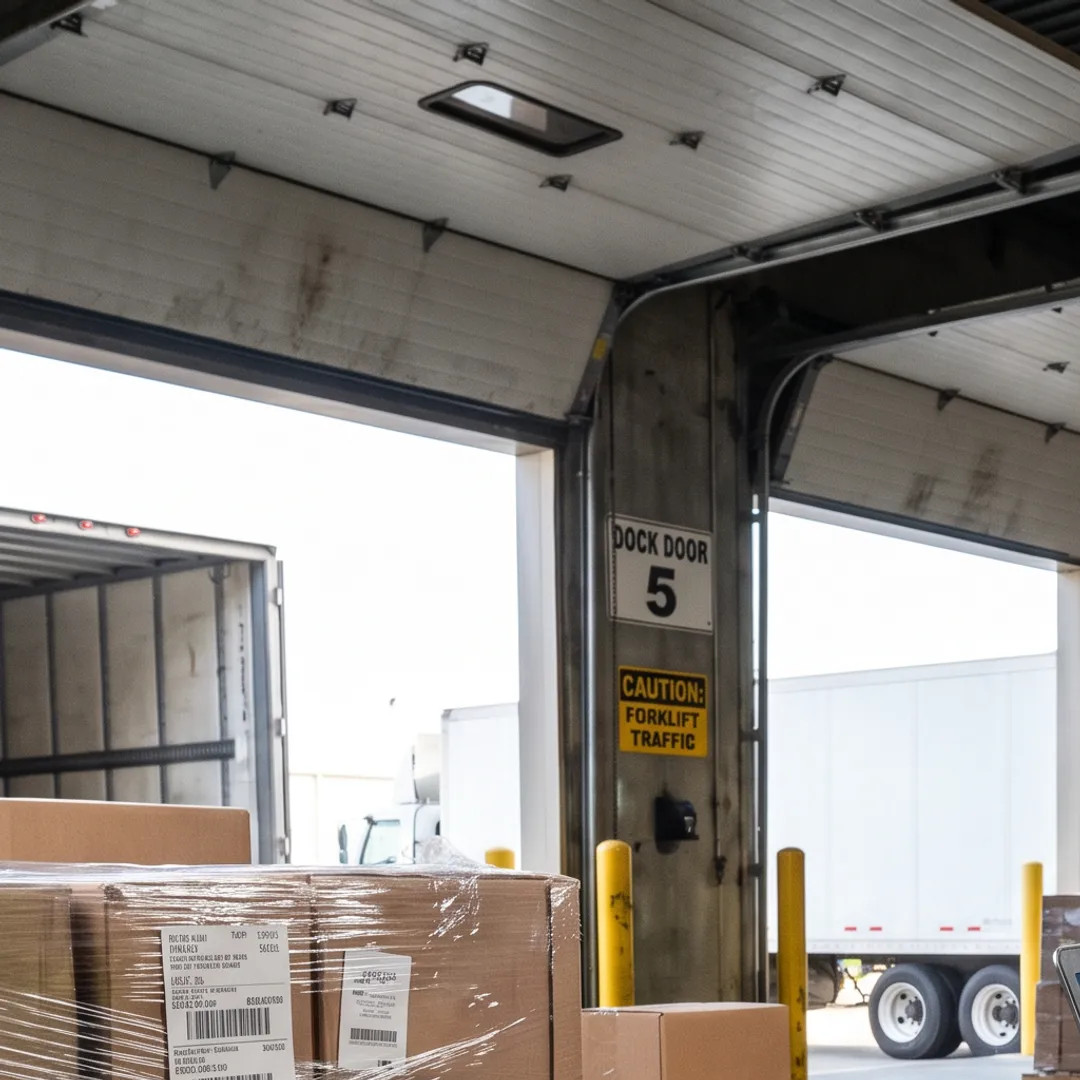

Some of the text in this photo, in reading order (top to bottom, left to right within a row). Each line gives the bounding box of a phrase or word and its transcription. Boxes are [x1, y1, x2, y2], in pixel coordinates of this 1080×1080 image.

[613, 524, 708, 564] DOCK DOOR
[646, 565, 677, 618] 5
[622, 675, 704, 704] CAUTION:
[625, 706, 700, 728] FORKLIFT
[630, 729, 696, 750] TRAFFIC
